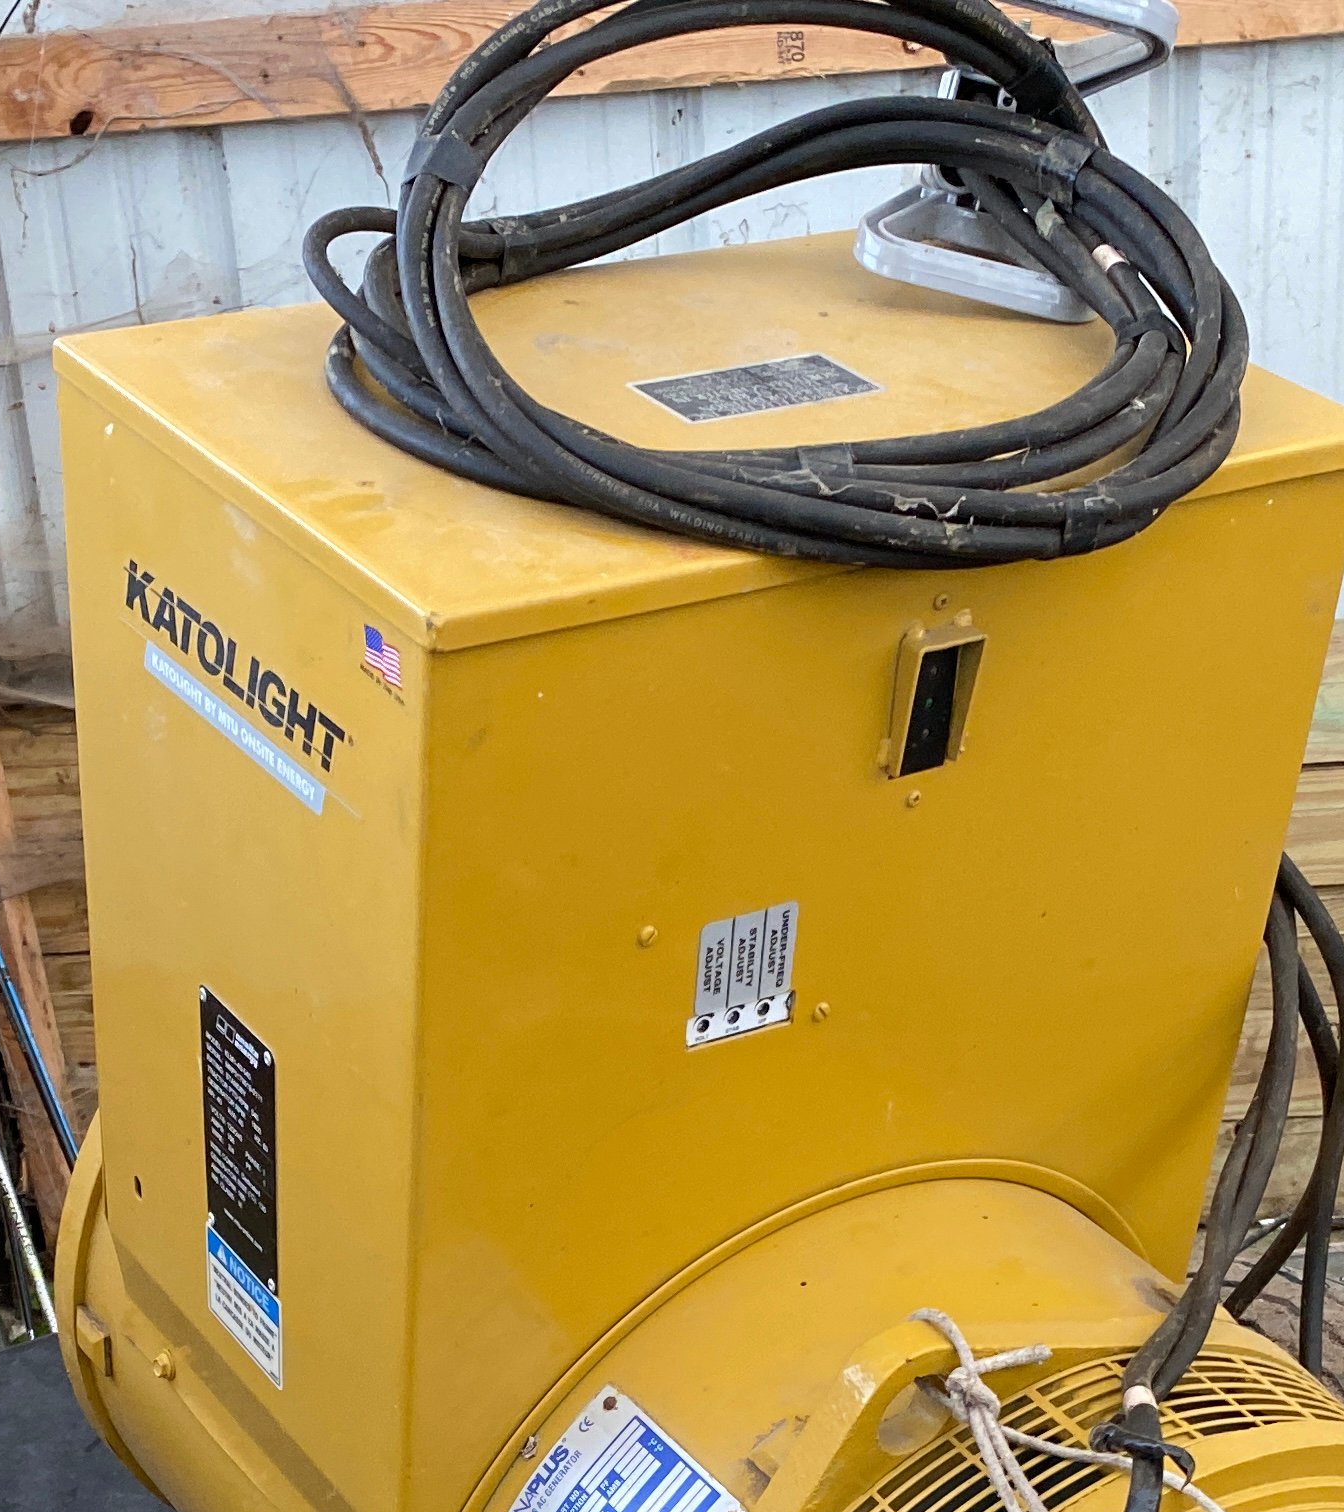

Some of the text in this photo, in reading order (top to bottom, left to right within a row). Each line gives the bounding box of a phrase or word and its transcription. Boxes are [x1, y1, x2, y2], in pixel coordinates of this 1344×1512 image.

[790, 31, 805, 62] 870
[669, 508, 724, 534] WELDING
[123, 558, 346, 772] KATOLIGHT
[151, 652, 202, 705] KATOLIGHT
[204, 695, 216, 717] BY
[239, 726, 275, 767] ONSITE
[276, 758, 315, 800] ENERGY
[703, 946, 713, 992] ADJUST
[713, 938, 724, 995] VOLTAGE
[735, 937, 746, 983] ADJUST
[744, 927, 757, 986] STABILITY
[767, 928, 777, 975] ADJUST
[775, 910, 790, 987] UNDER-FREQ
[229, 1257, 269, 1311] NOTICE
[535, 1495, 546, 1509] AC
[544, 1450, 582, 1496] GENERATOR
